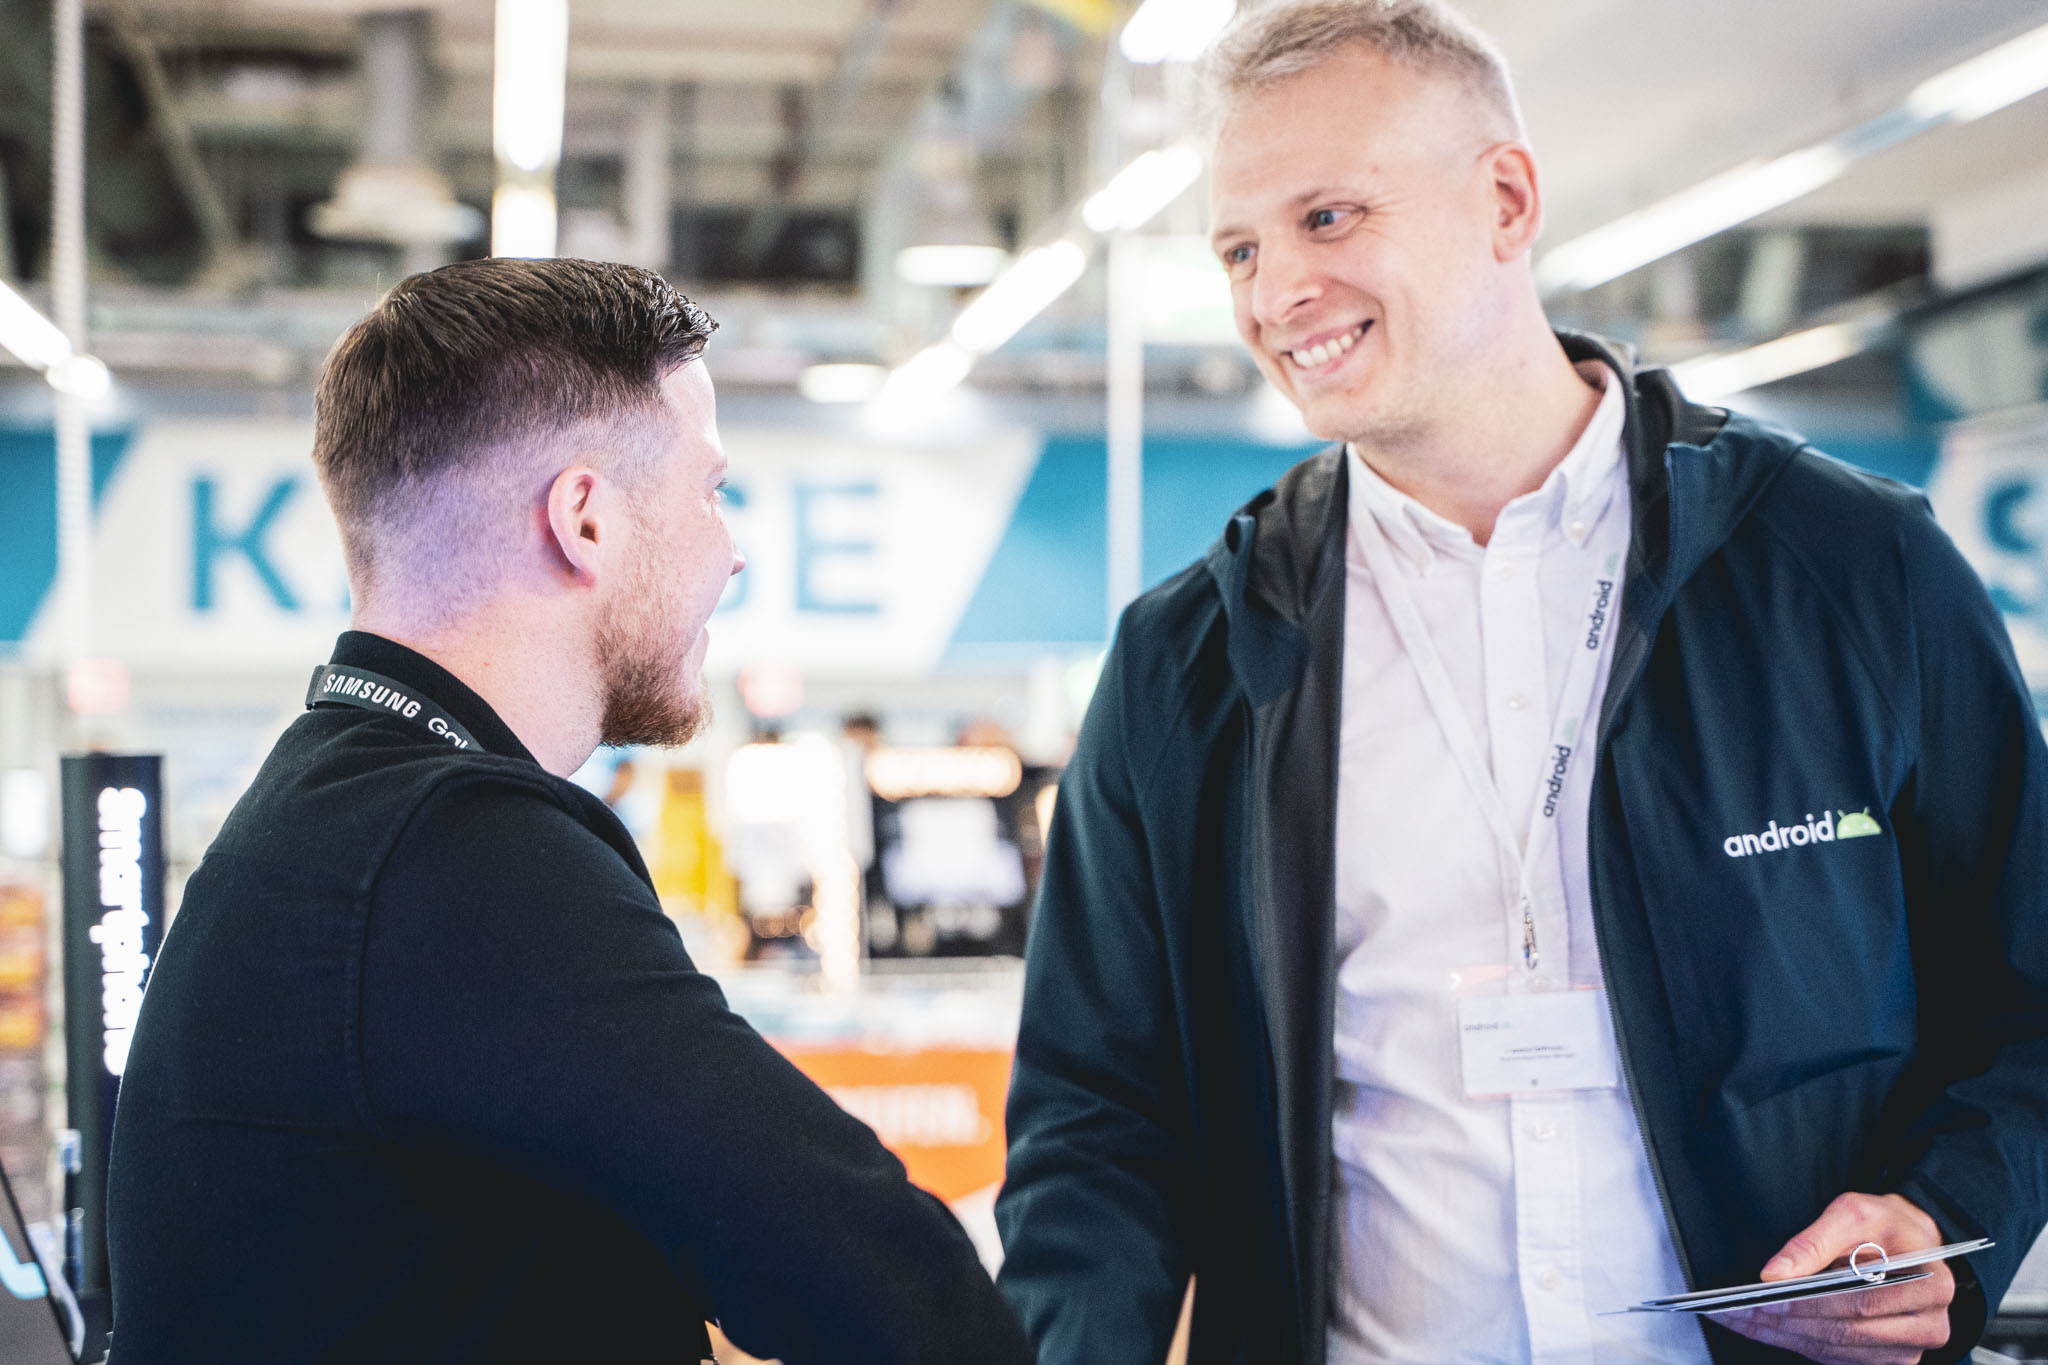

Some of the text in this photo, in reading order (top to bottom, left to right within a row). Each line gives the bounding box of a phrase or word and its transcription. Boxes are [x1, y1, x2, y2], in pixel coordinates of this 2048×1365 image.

[1585, 579, 1613, 650] android
[323, 673, 422, 718] SAMSUNG
[1543, 744, 1571, 818] android
[1723, 810, 1835, 857] android
